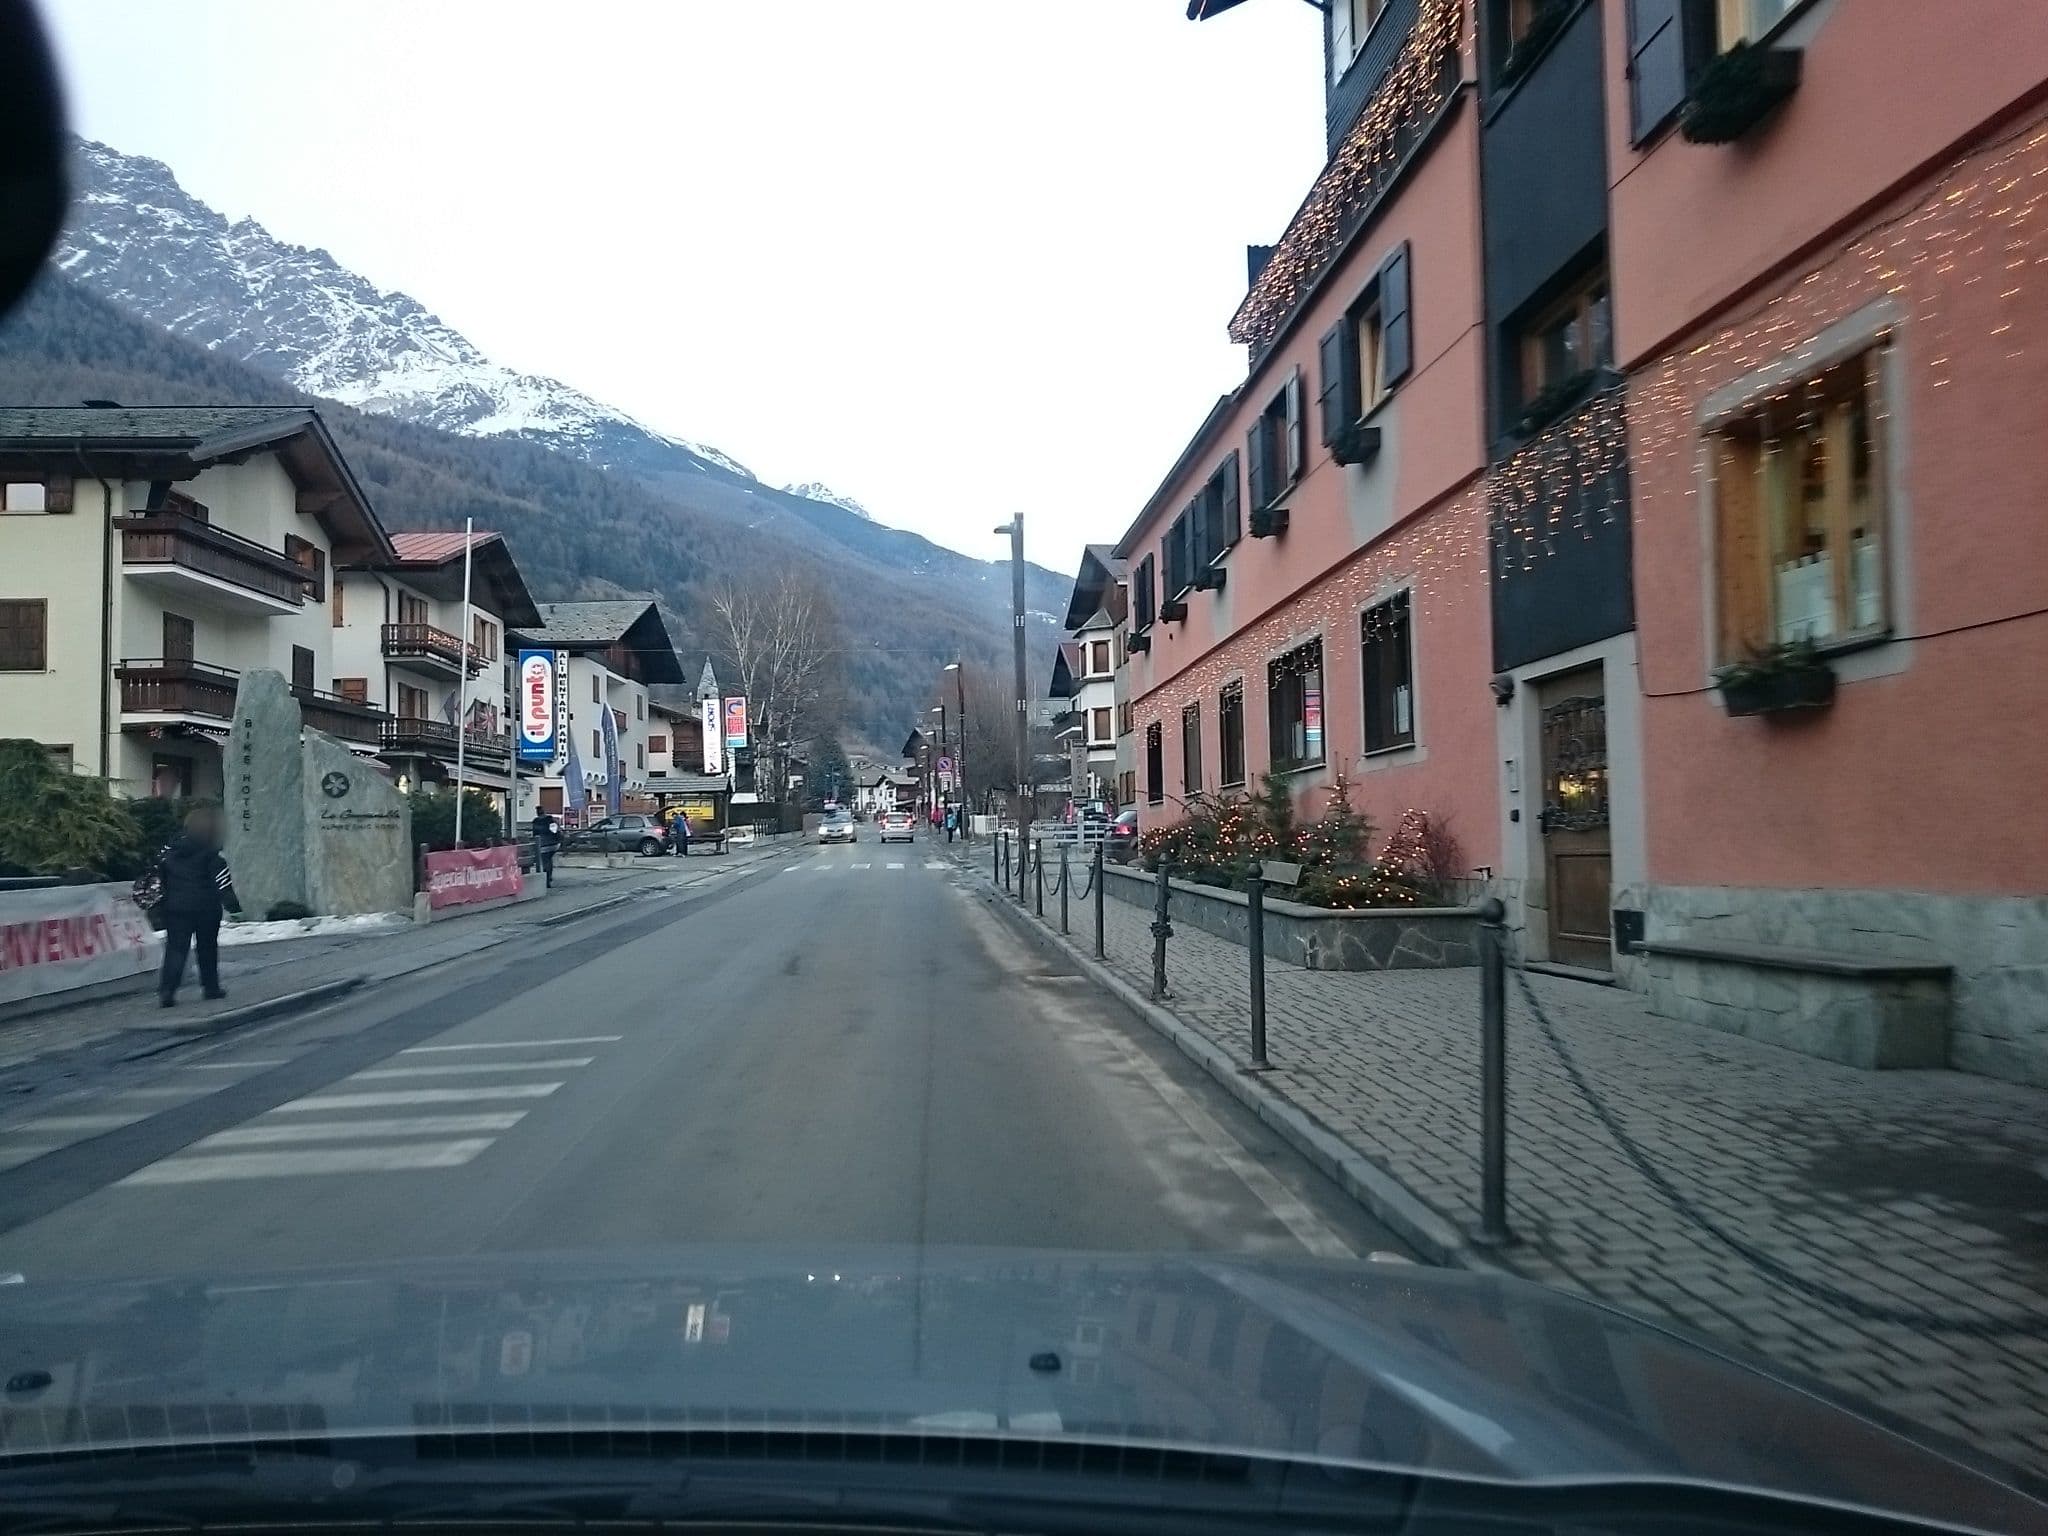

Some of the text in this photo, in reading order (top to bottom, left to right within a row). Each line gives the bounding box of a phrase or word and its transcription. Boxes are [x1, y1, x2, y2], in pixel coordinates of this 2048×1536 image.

[558, 653, 567, 765] ALIMENTARI PANINI
[241, 718, 252, 832] BIKE HOTEL
